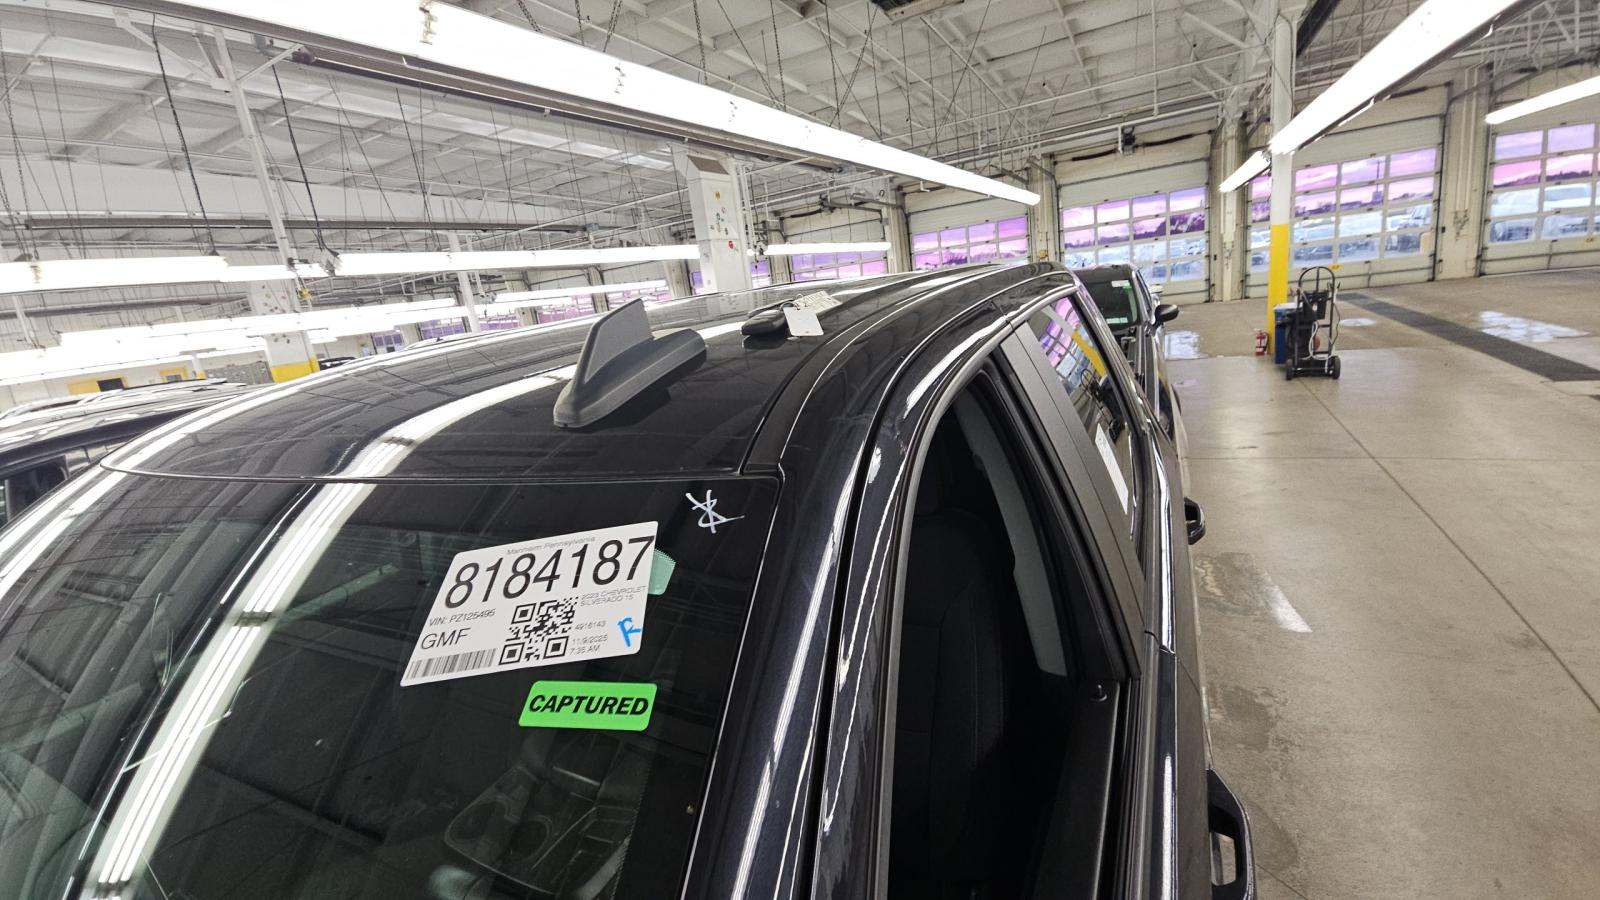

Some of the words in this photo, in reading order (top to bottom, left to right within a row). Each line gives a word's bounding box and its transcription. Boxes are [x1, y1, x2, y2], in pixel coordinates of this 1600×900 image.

[543, 536, 595, 549] Pennsylvania
[445, 535, 655, 609] 8184187
[600, 585, 646, 597] CHEVROLET
[579, 595, 622, 606] SILVERADO
[429, 616, 447, 626] VIN:
[421, 628, 471, 650] GMF
[529, 695, 649, 716] CAPTURED
